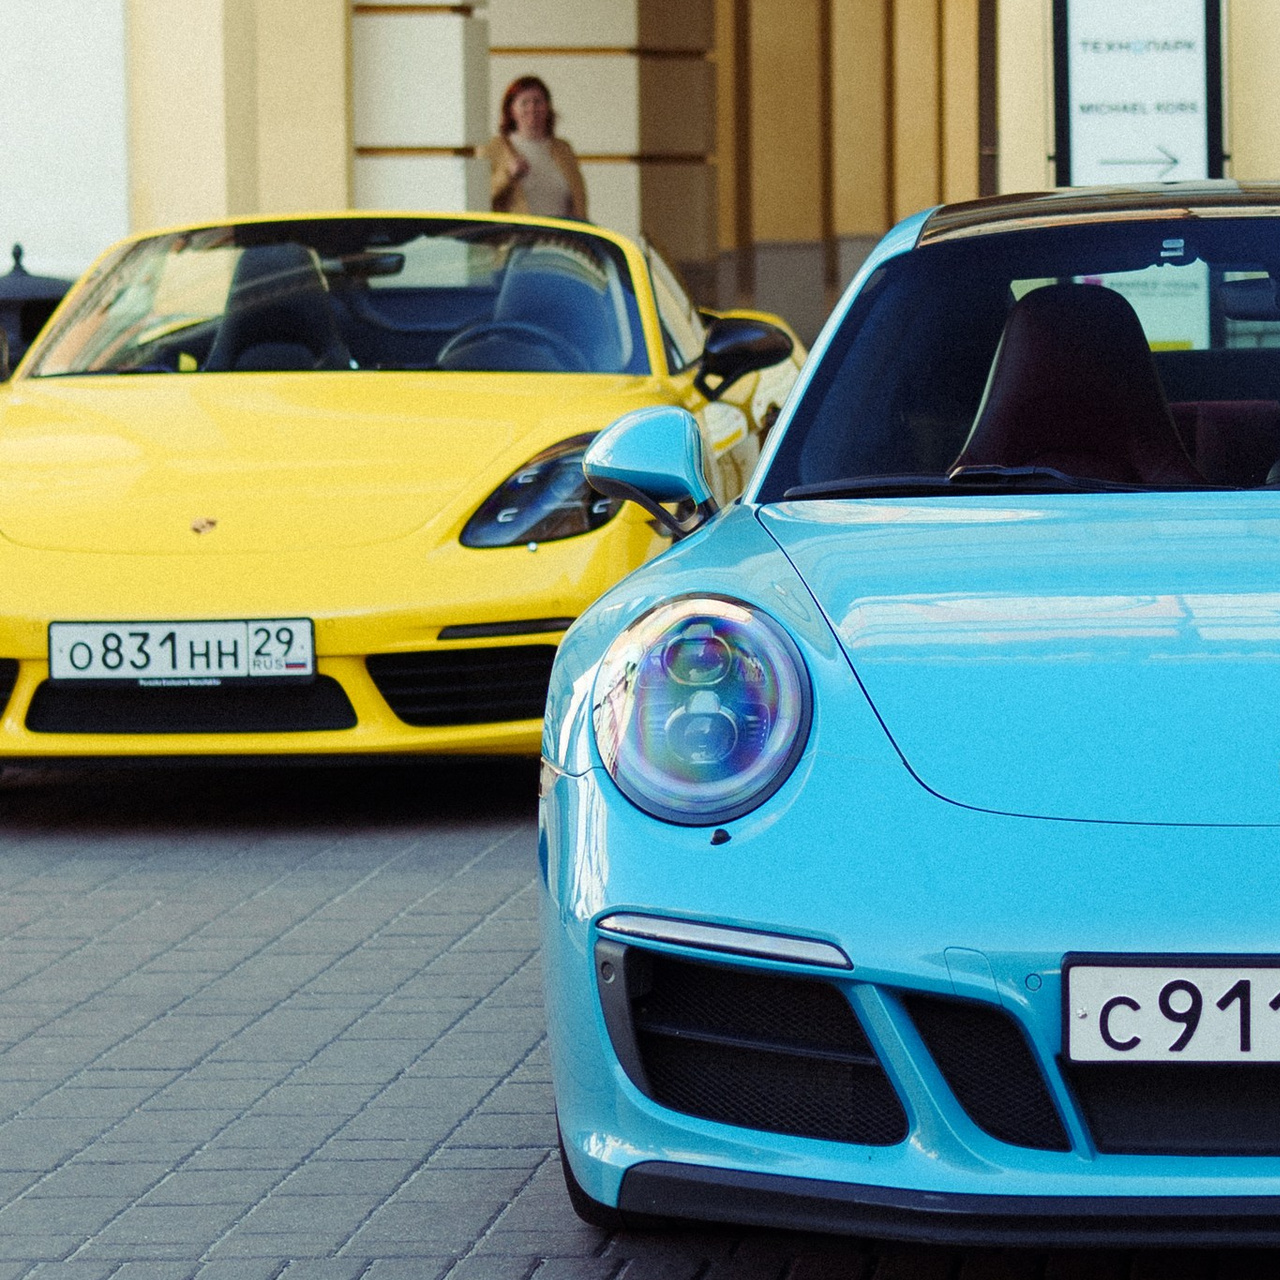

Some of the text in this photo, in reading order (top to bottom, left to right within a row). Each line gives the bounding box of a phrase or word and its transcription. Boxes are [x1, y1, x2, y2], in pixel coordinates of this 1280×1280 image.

[1079, 39, 1196, 54] ТЕХНОПАРК
[1079, 101, 1198, 115] MICHAEL KORS
[254, 627, 294, 657] 29
[252, 658, 284, 671] RUS
